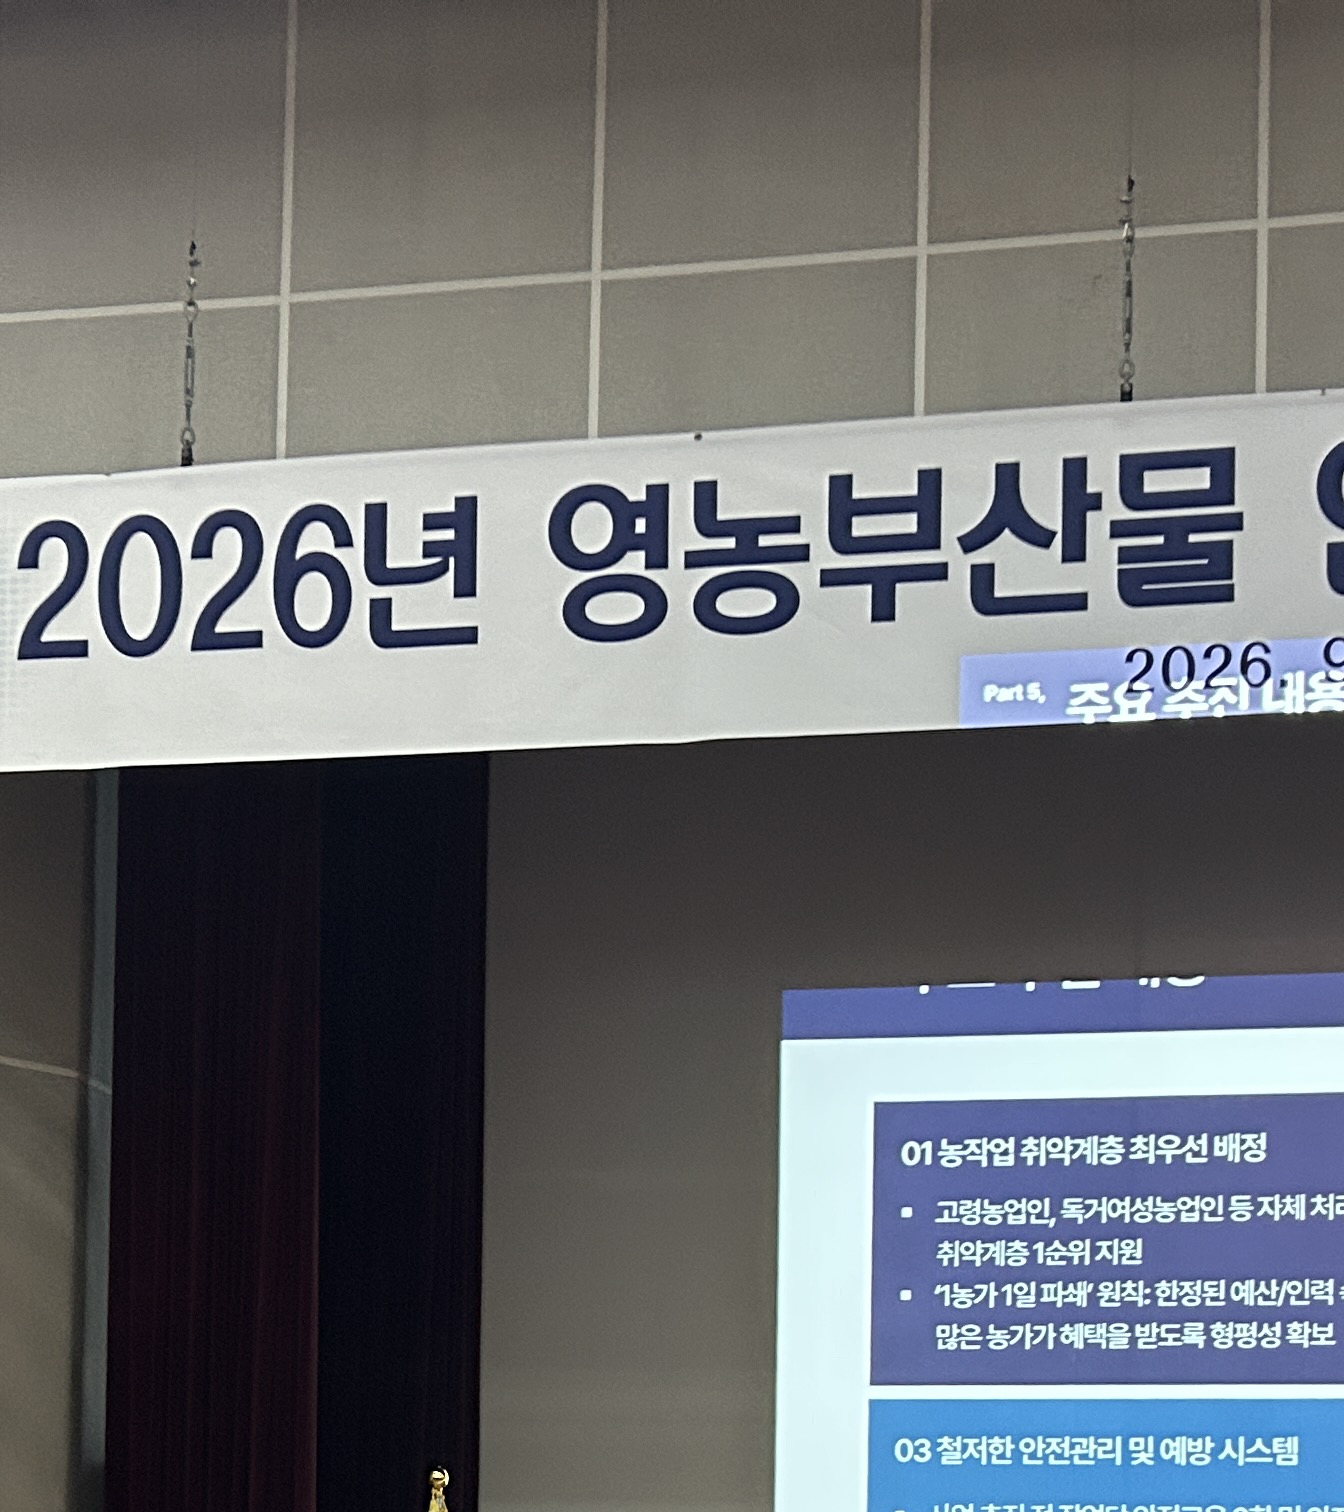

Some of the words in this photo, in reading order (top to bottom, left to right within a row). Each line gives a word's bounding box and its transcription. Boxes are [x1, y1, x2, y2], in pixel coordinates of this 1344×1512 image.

[17, 494, 479, 660] 2026년
[548, 447, 1243, 642] 영농부산물
[983, 683, 1024, 702] Part
[901, 1141, 932, 1165] 01
[938, 1137, 1014, 1168] 농작업
[1020, 1135, 1125, 1166] 취약계층
[1129, 1133, 1208, 1164] 최우선
[1214, 1132, 1266, 1163] 배정
[935, 1198, 1056, 1228] 고령농업인,
[1061, 1195, 1224, 1224] 독거여성농업인
[1228, 1195, 1253, 1221] 등
[1257, 1194, 1305, 1221] 자체
[936, 1240, 1029, 1267] 취약계층
[1033, 1239, 1090, 1265] 1순위
[1095, 1238, 1142, 1265] 지원
[1001, 1281, 1036, 1308] 1일
[1097, 1280, 1151, 1307] 원칙:
[1155, 1280, 1225, 1306] 한정된
[1230, 1279, 1334, 1306] 예산/인력
[936, 1324, 983, 1350] 많은
[986, 1323, 1055, 1350] 농가가
[1060, 1323, 1131, 1349] 혜택을
[1135, 1322, 1206, 1349] 받도록
[1210, 1322, 1281, 1349] 형평성
[1286, 1321, 1336, 1348] 확보
[895, 1439, 931, 1462] 03
[937, 1436, 1015, 1465] 철저한
[1019, 1436, 1121, 1465] 안전관리
[1129, 1436, 1154, 1465] 및
[1160, 1436, 1214, 1466] 예방
[1218, 1436, 1298, 1466] 시스템
